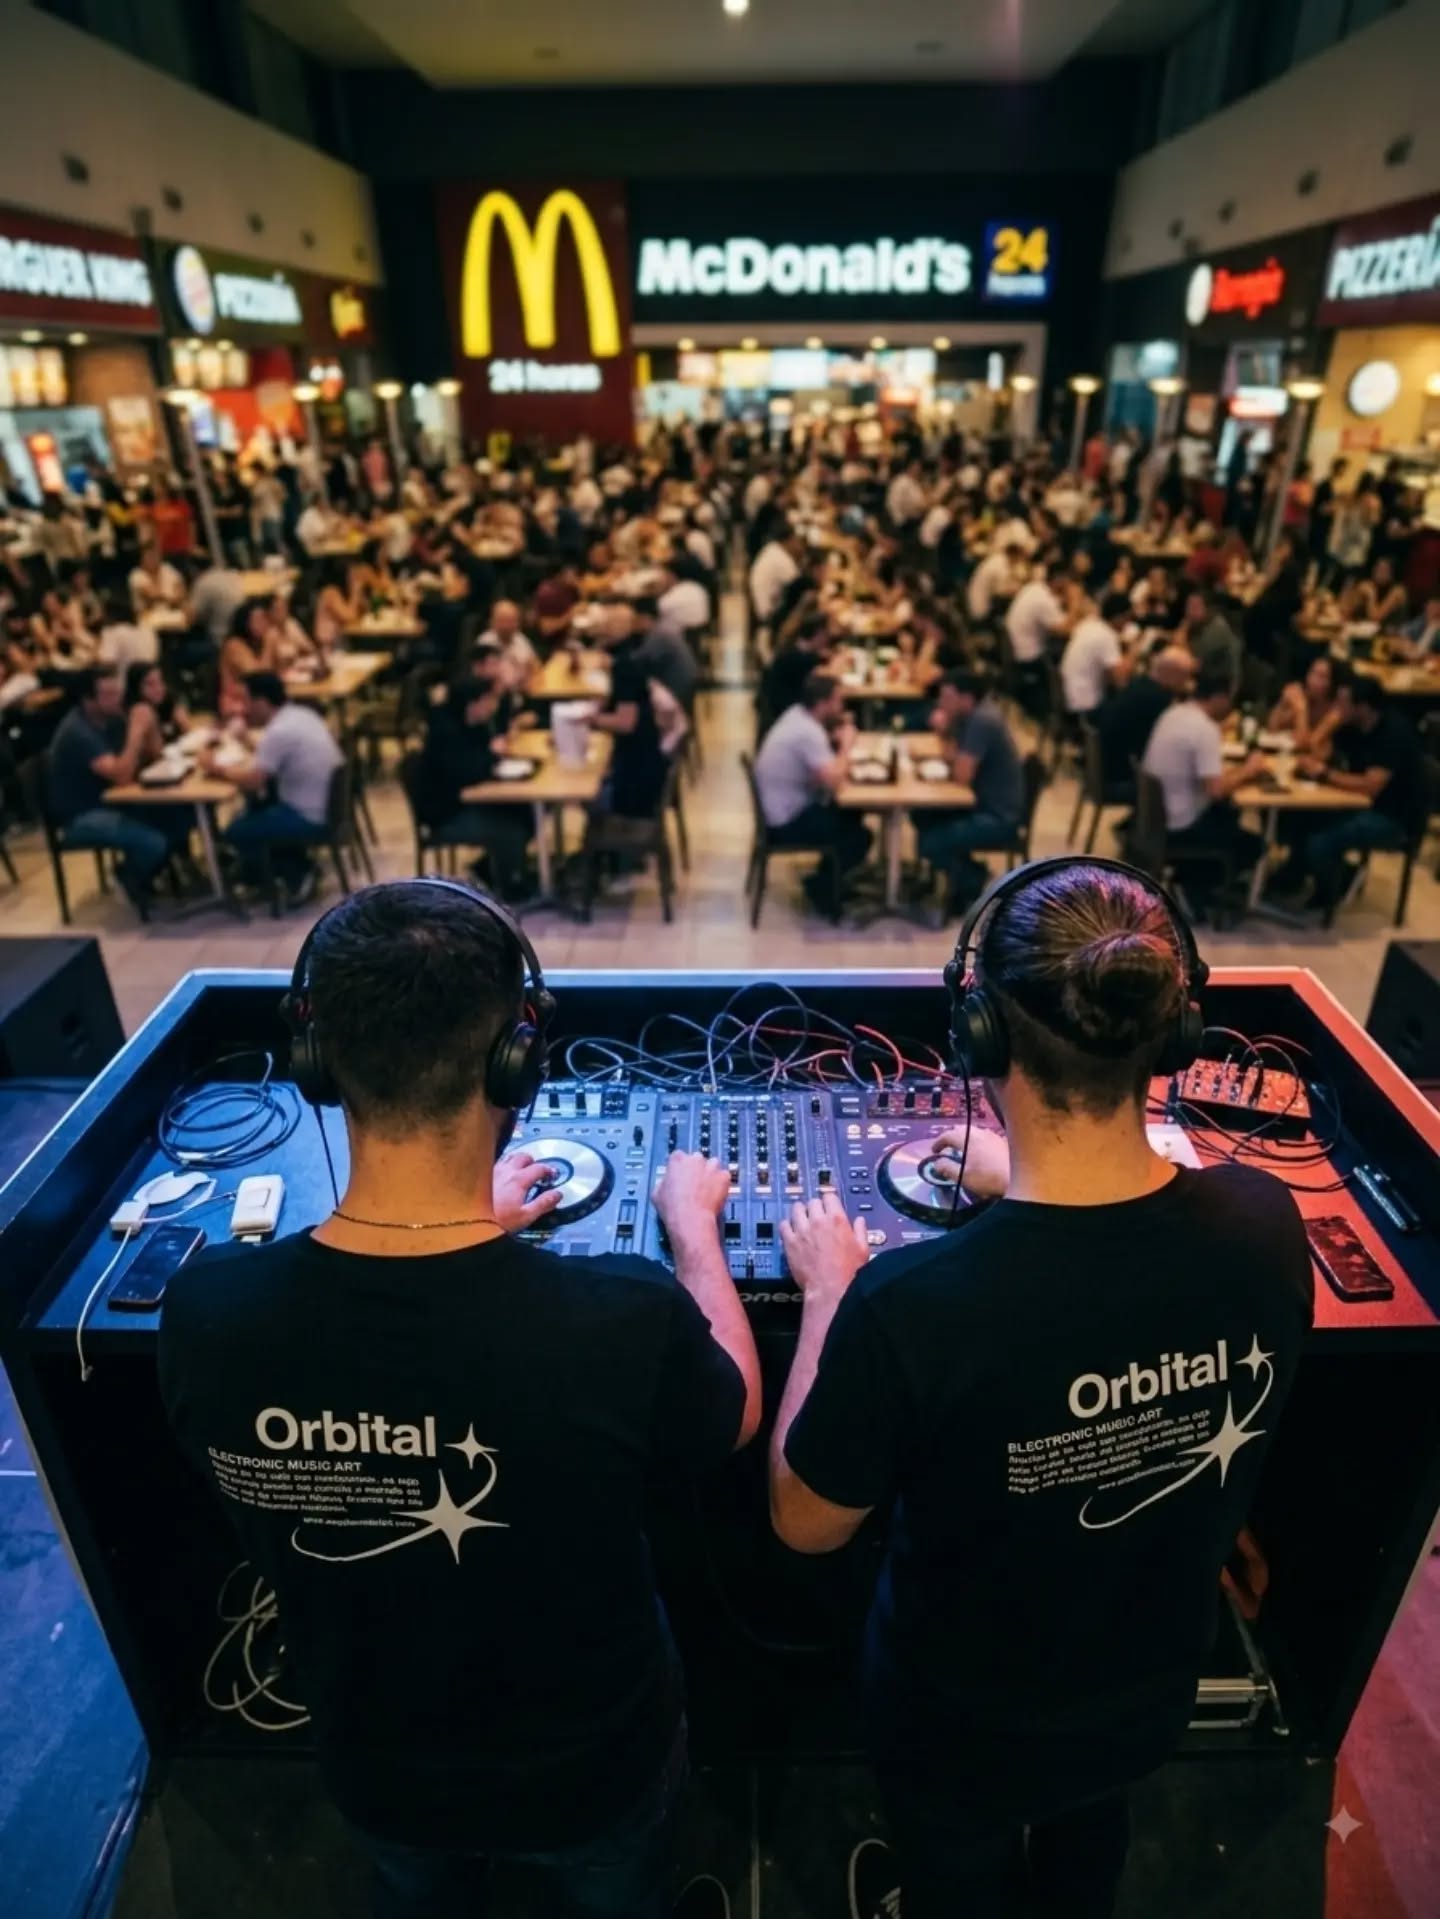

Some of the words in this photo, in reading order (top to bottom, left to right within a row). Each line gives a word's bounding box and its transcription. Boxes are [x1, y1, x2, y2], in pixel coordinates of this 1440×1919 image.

[637, 237, 972, 296] McDonald's
[990, 227, 1048, 275] 24
[1068, 1339, 1228, 1419] Orbital
[255, 1407, 437, 1457] Orbital
[1137, 1407, 1163, 1425] ART
[334, 1461, 362, 1473] ART
